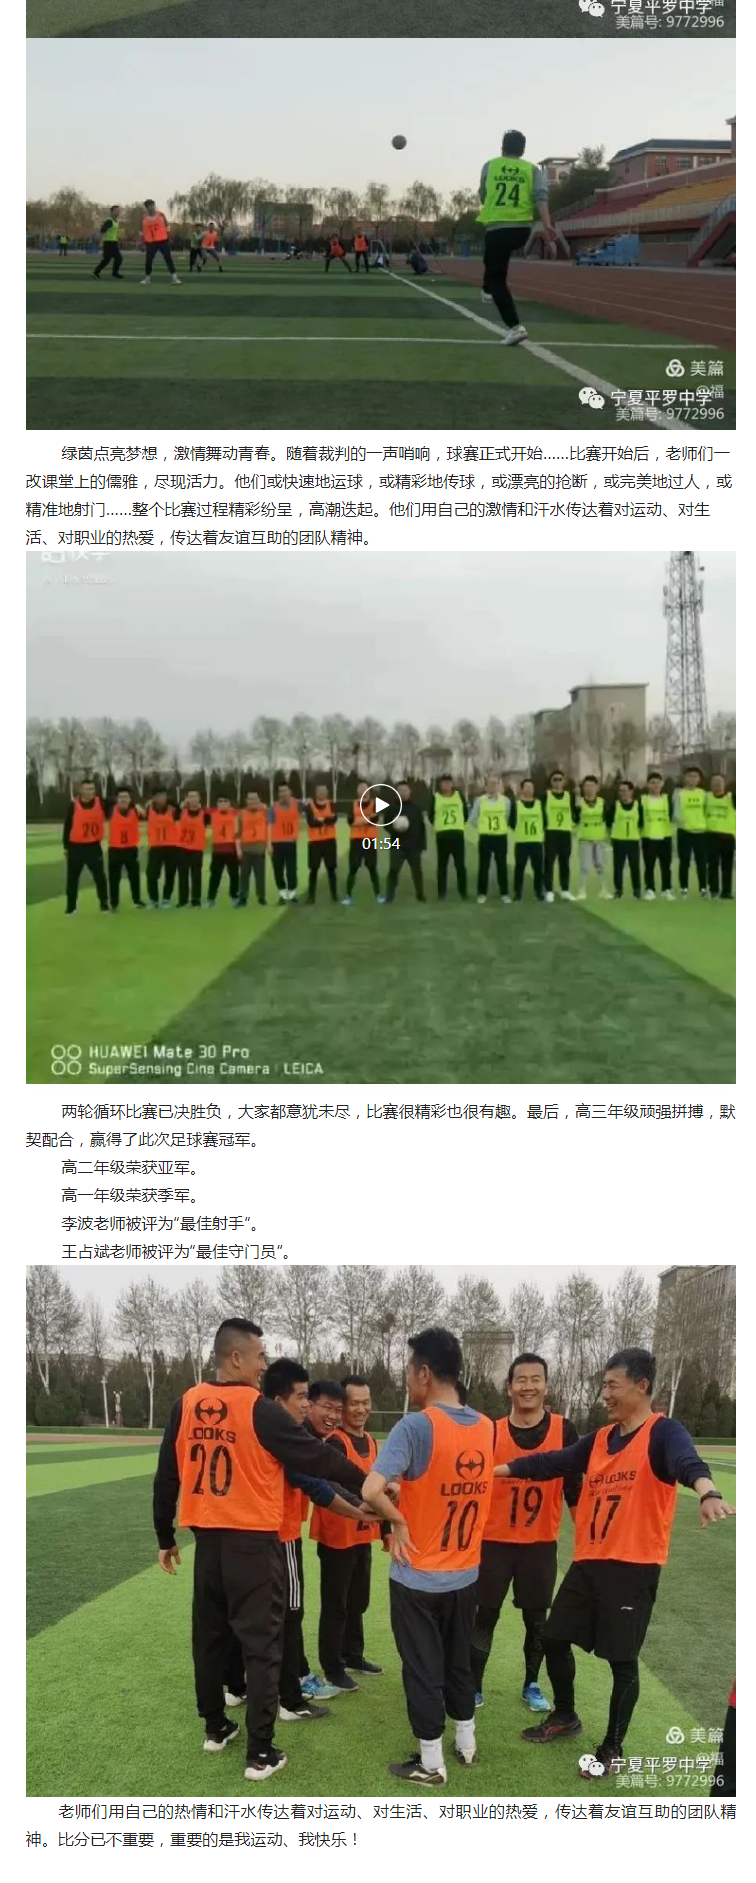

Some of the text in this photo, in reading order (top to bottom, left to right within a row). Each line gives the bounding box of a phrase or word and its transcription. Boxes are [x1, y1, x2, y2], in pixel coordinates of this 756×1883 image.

[495, 182, 519, 208] 24
[26, 473, 732, 489] 改课堂上的儒雅，尽现活力。他们或快速地运球，或精彩地传球，或漂亮的抢断，或完美地过人，或
[26, 529, 369, 545] 活、对职业的热爱，传达着友谊互助的团队精神。
[443, 810, 457, 825] 25
[488, 816, 500, 831] 13
[557, 811, 564, 826] 9
[525, 821, 537, 835] 16
[62, 1103, 735, 1120] 两轮循环比赛已决胜负，大家都意犹未尽，比赛很精彩也很有趣。最后，高三年级顽强拼搏，默
[26, 1131, 255, 1147] 契配合，赢得了此次足球赛冠军。
[62, 1159, 195, 1175] 高二年级荣获亚军。
[62, 1187, 195, 1203] 高一年级荣获季军。
[190, 1443, 232, 1497] 20
[440, 1481, 488, 1497] LOOKS
[509, 1486, 543, 1528] 19
[440, 1500, 479, 1551] 10
[590, 1494, 622, 1545] 17
[59, 1804, 736, 1819] 老师们用自己的热情和汗水传达着对运动、对生活、对职业的热爱，传达着友谊互助的团队精
[26, 1831, 356, 1847] 神。比分已不重要，重要的是我运动、我快乐！
